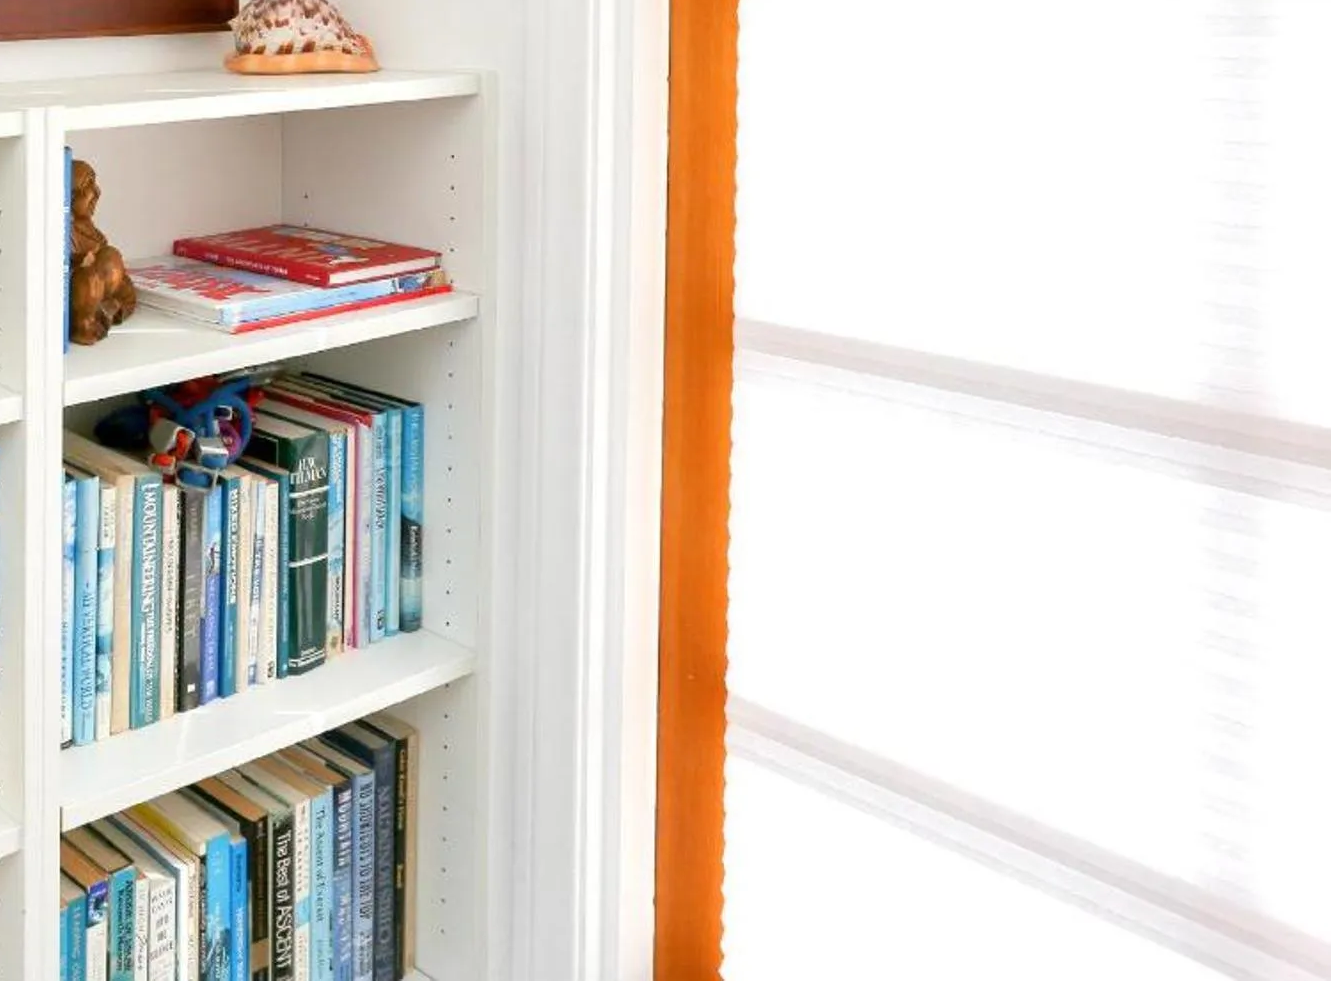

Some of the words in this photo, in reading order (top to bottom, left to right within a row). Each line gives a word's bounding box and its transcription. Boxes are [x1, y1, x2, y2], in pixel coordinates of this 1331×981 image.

[141, 491, 160, 612] MOUNTAINEERING
[228, 535, 238, 605] EMOTIONS
[359, 783, 372, 799] NO
[315, 807, 326, 828] The
[337, 788, 353, 867] MOUNTAIN
[358, 802, 372, 862] SHORTCUTS
[276, 829, 292, 859] The
[315, 833, 326, 867] Ascent
[276, 859, 289, 887] Best
[315, 869, 326, 881] of
[359, 863, 372, 878] TO
[277, 889, 292, 901] of
[315, 882, 326, 923] Everest
[359, 879, 372, 899] THE
[359, 900, 373, 921] TOP
[275, 904, 293, 969] ASCENT
